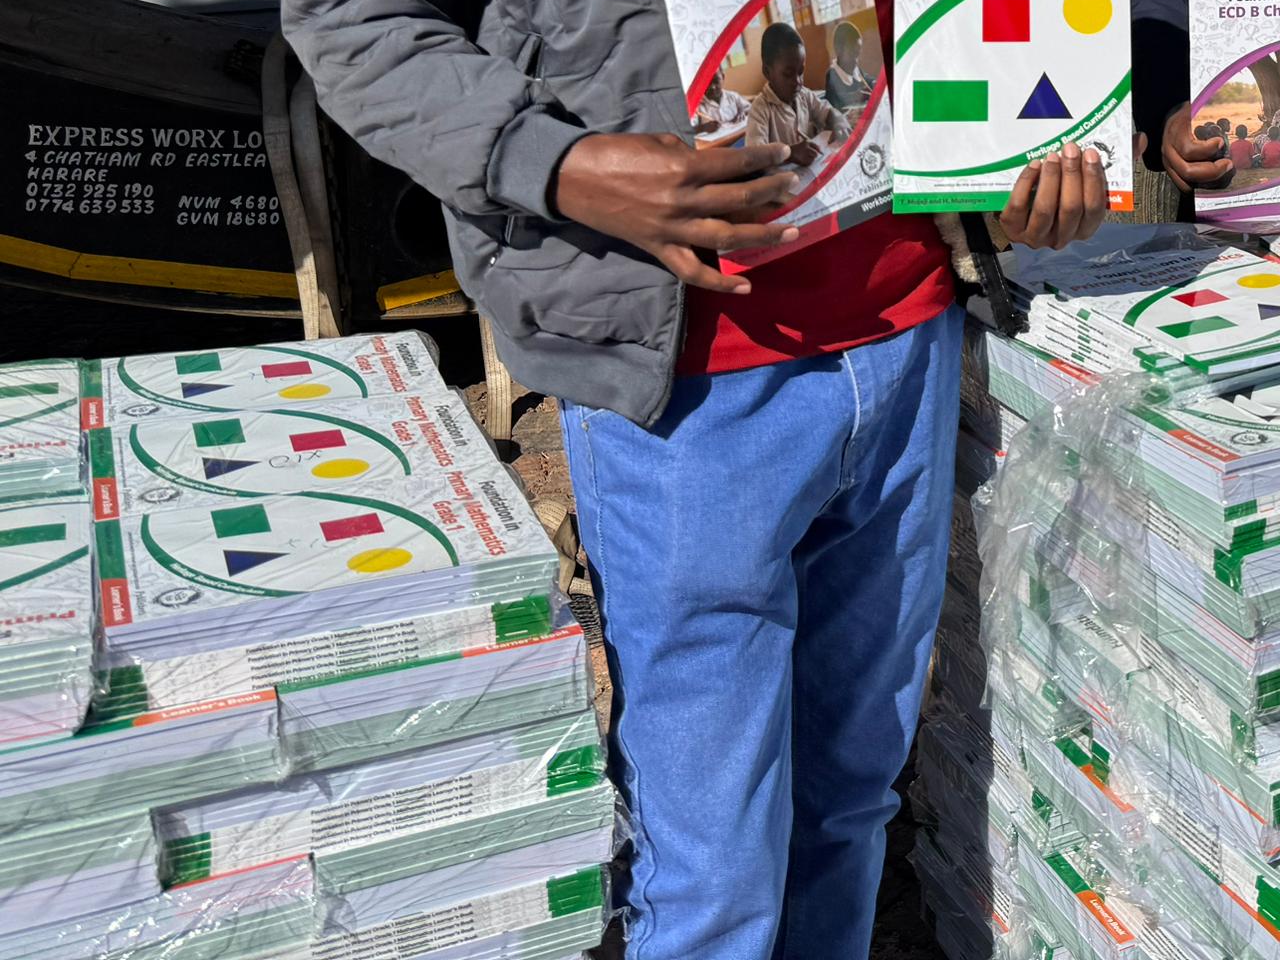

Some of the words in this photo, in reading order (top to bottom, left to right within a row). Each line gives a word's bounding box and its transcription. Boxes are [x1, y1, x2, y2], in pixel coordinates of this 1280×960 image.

[1219, 6, 1246, 19] ECD
[1250, 6, 1259, 17] B
[28, 124, 143, 147] EXPRESS
[151, 128, 224, 148] WORX
[25, 151, 37, 163] 4
[44, 151, 142, 166] CHATHAM
[151, 153, 176, 166] RD
[186, 153, 266, 167] EASTLEA
[28, 167, 108, 182] HARARE
[26, 183, 75, 198] 0732
[83, 184, 117, 198] 925
[124, 184, 154, 197] 190
[230, 195, 279, 210] 4680
[26, 198, 74, 213] 0774
[79, 199, 116, 214] 639
[120, 199, 154, 214] 533
[227, 212, 280, 225] 18680
[404, 396, 429, 422] Primary
[418, 422, 454, 467] Mathematics
[434, 405, 463, 439] Foundation
[432, 500, 457, 525] Grade
[444, 471, 474, 501] Primary
[463, 501, 507, 556] Mathematics
[479, 480, 514, 523] Foundation
[505, 522, 522, 531] in
[160, 698, 225, 720] Learner's
[226, 692, 262, 707] Book
[1090, 899, 1113, 924] Learner's
[1111, 921, 1126, 936] Book
